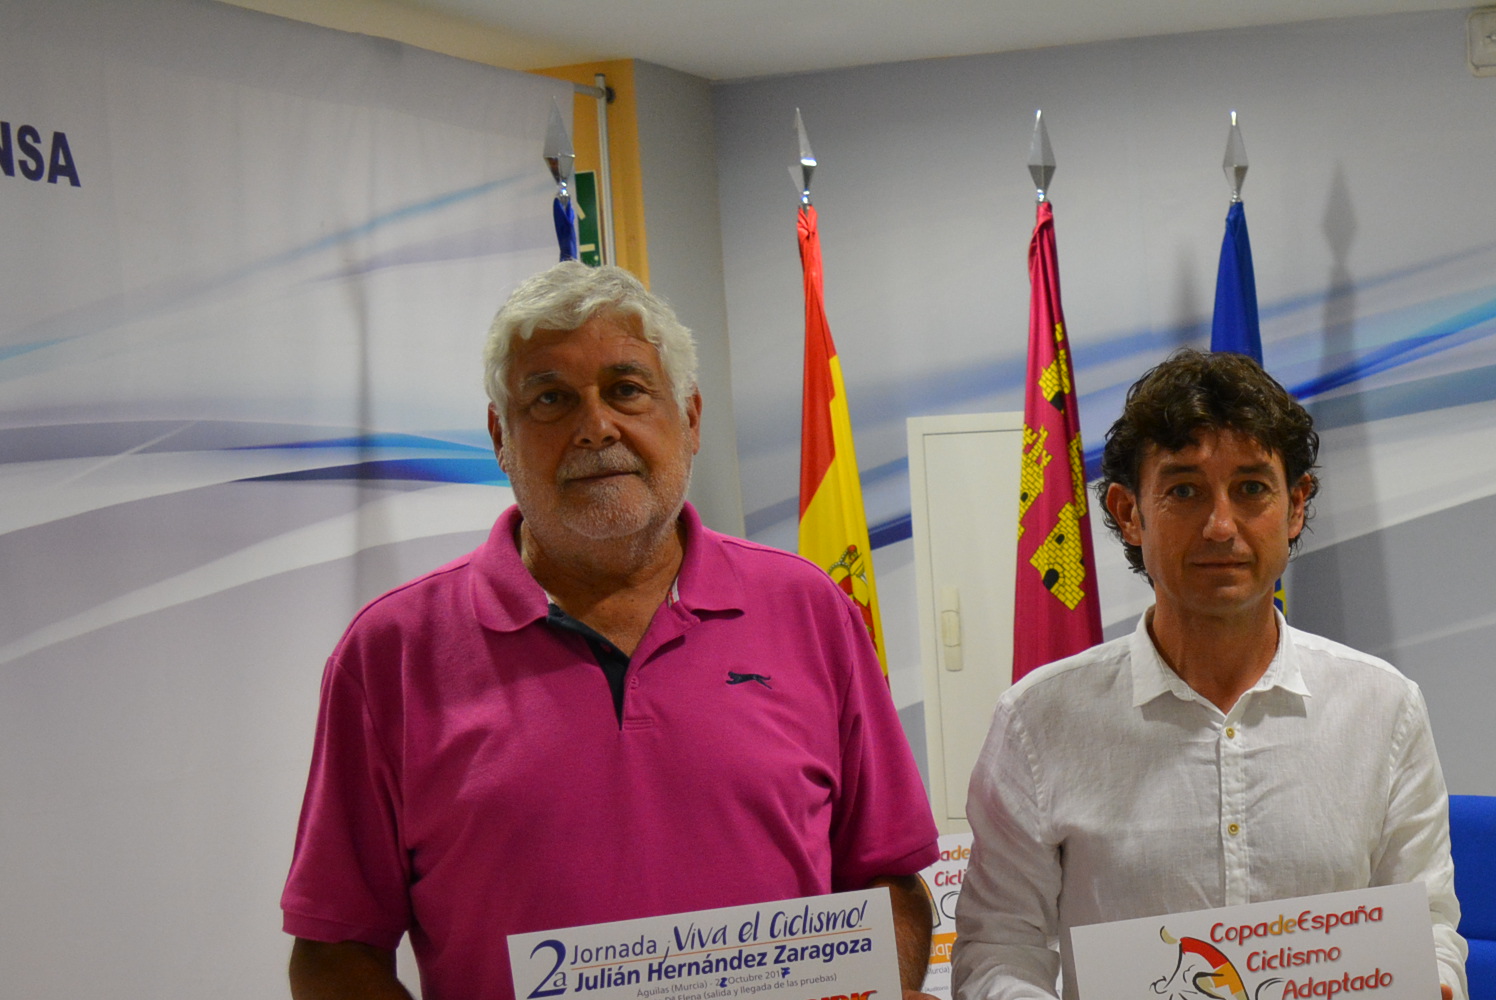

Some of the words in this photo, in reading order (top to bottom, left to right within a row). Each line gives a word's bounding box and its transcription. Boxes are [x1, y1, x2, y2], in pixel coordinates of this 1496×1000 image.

[934, 869, 967, 887] Cicli
[566, 933, 658, 966] Jornada
[661, 923, 726, 964] ¡Viva
[738, 911, 759, 942] el
[769, 900, 867, 938] Ciclismo!
[574, 965, 640, 992] Julián
[647, 948, 767, 982] Hernández
[773, 937, 872, 969] Zaragoza
[1246, 946, 1342, 973] Ciclismo
[635, 983, 671, 1000] Águilas
[670, 978, 708, 994] (Murcia)
[727, 971, 763, 986] Octubre
[703, 988, 732, 999] (salida
[733, 989, 738, 997] y
[739, 982, 772, 995] llegada
[773, 980, 785, 989] de
[785, 979, 799, 987] las
[799, 972, 837, 987] pruebas)
